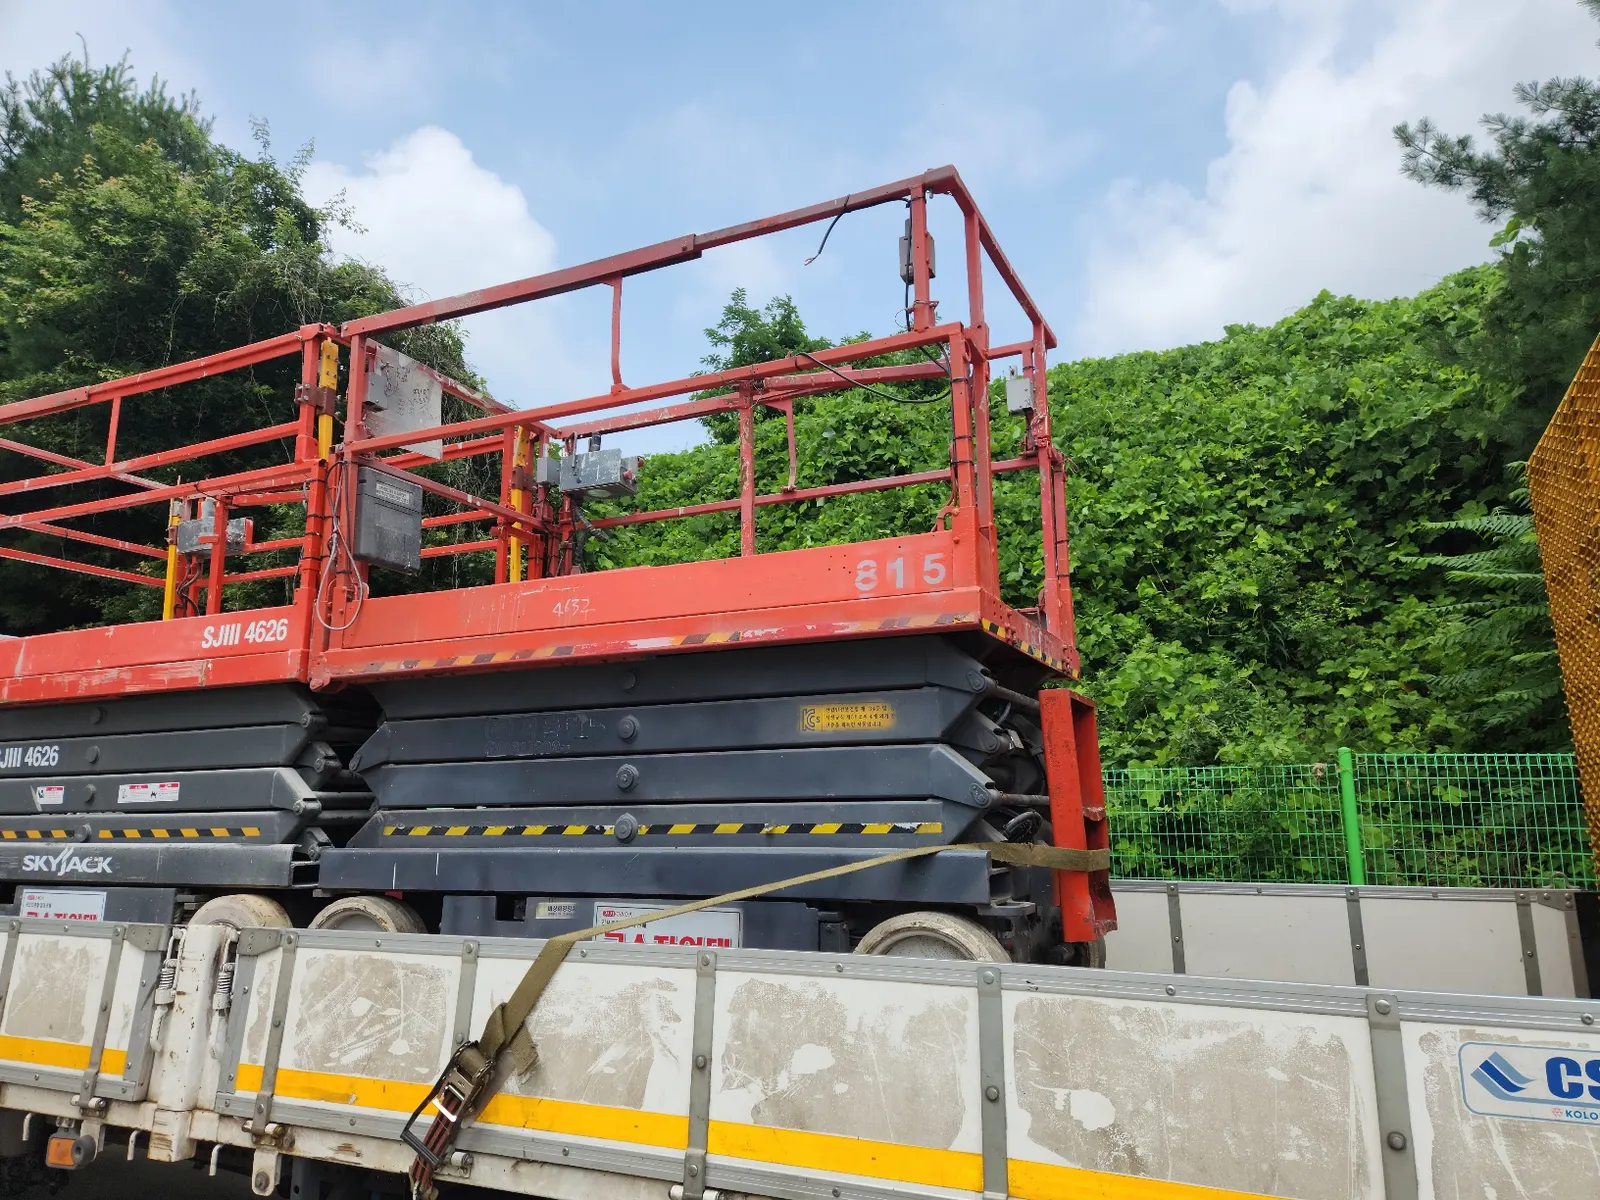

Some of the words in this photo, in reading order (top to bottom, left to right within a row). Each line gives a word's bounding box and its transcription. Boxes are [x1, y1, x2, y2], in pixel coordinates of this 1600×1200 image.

[243, 618, 288, 643] 4626
[0, 747, 22, 769] JIII
[24, 745, 59, 767] 4626
[22, 846, 113, 877] SKYJACK
